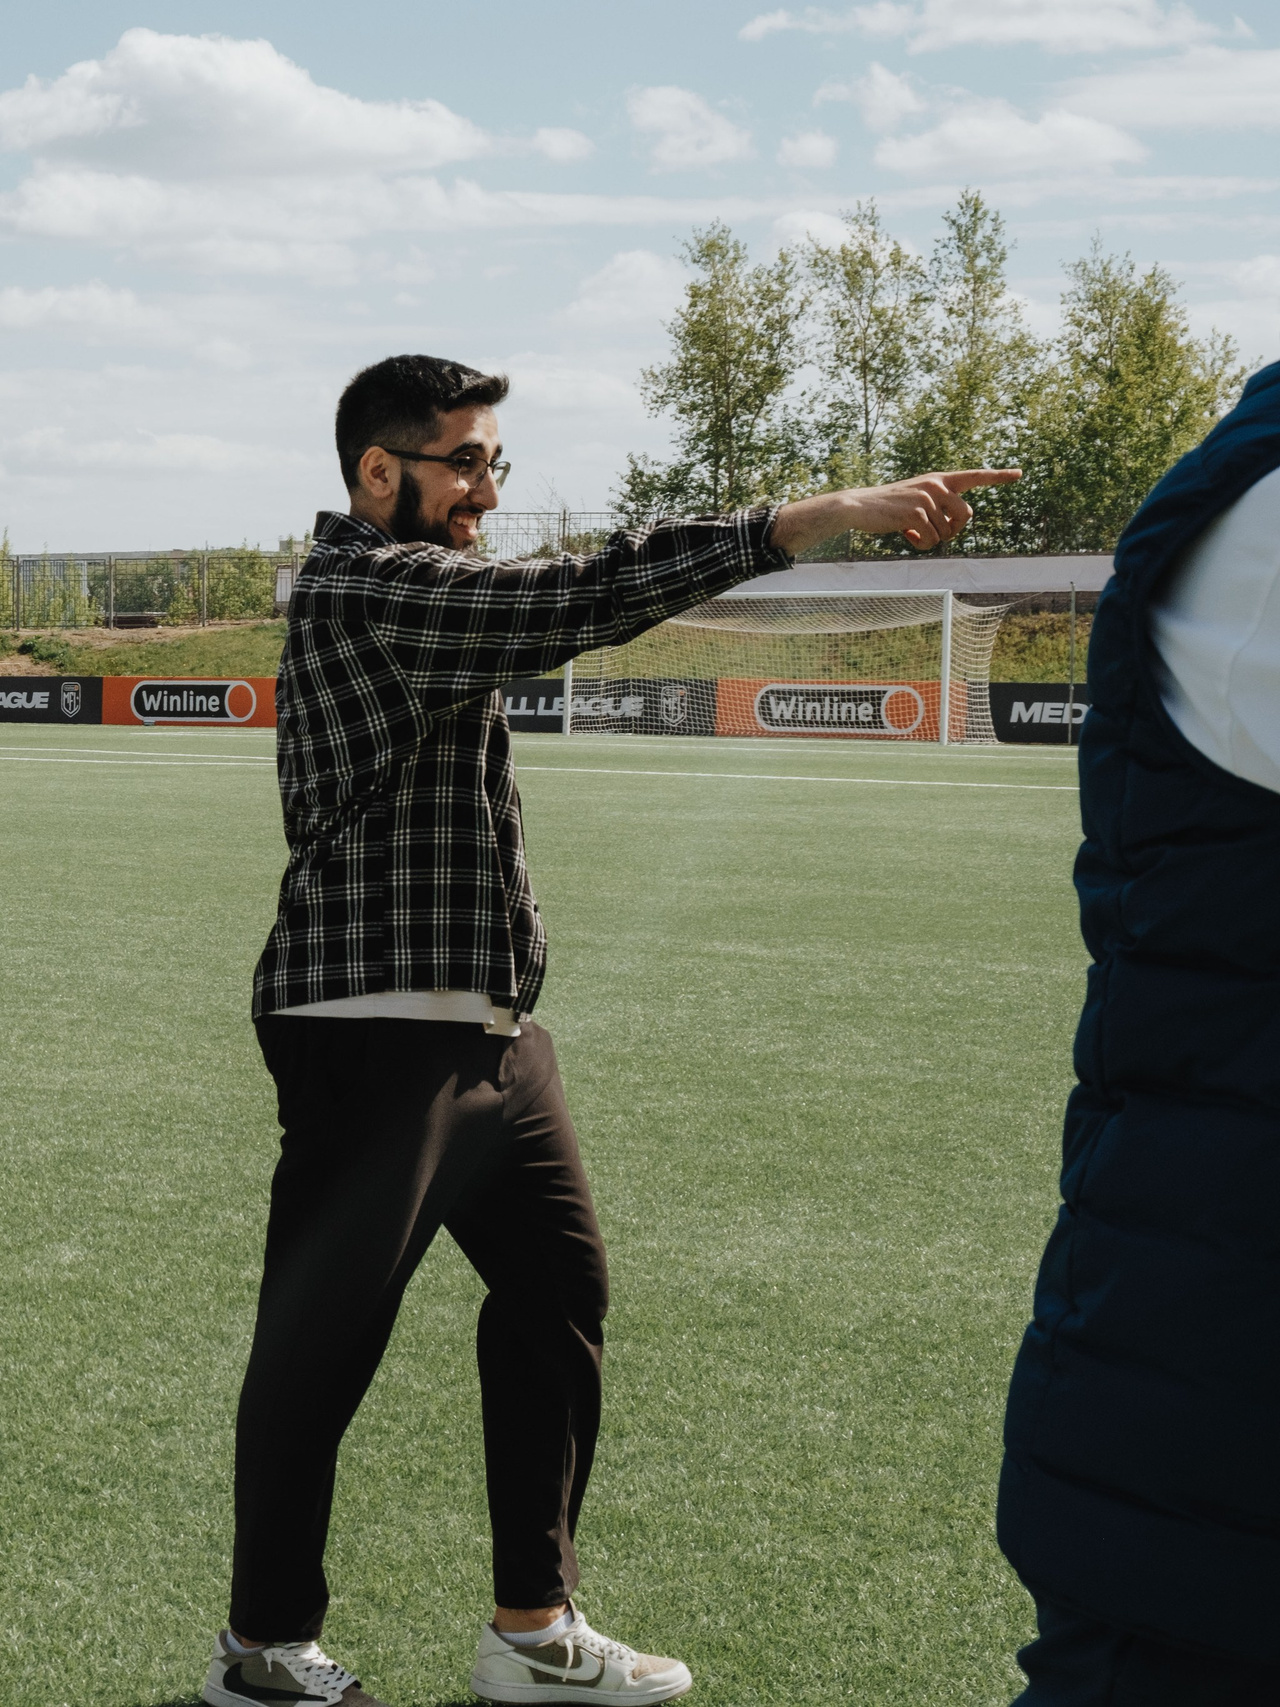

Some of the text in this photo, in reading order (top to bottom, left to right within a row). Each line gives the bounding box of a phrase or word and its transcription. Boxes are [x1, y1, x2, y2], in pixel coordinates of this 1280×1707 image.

[142, 690, 220, 712] Winline
[769, 696, 874, 721] Winline
[1009, 701, 1090, 724] MED
